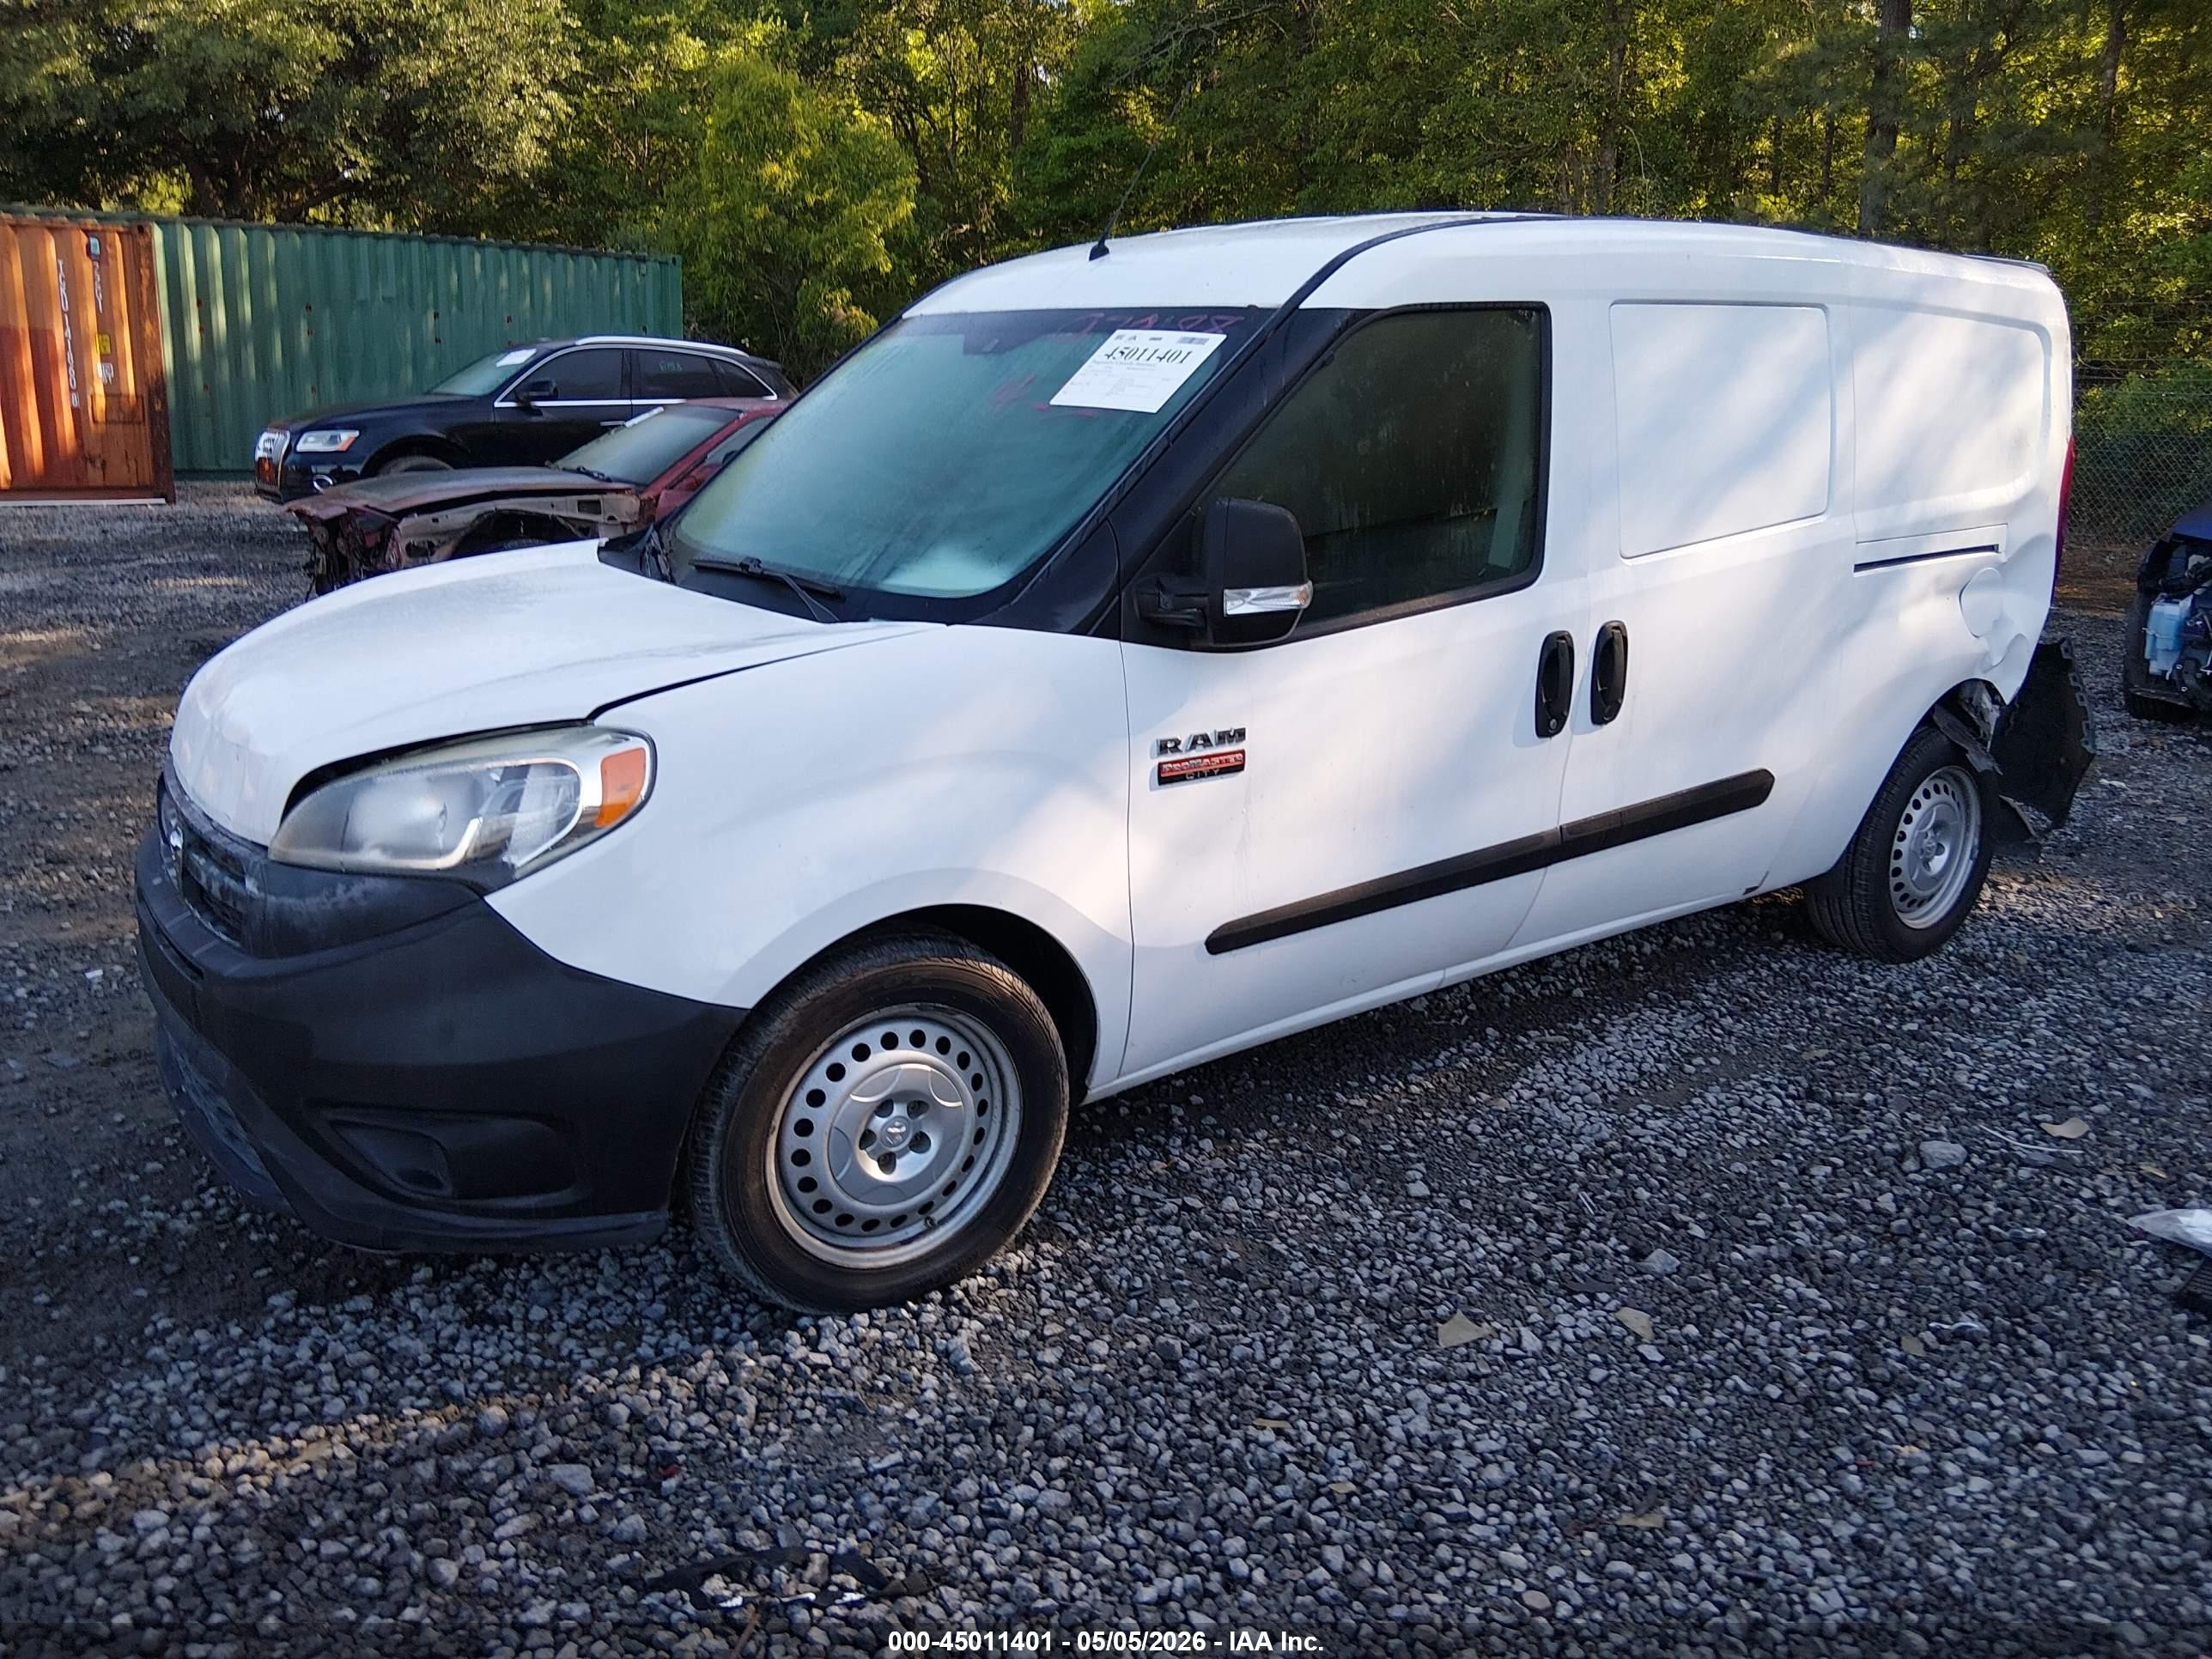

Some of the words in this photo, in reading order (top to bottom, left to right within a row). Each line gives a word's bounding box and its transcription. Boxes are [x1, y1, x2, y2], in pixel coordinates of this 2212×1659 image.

[1104, 346, 1193, 364] 45011401
[1156, 727, 1246, 757] RAM
[1185, 768, 1220, 781] CITY
